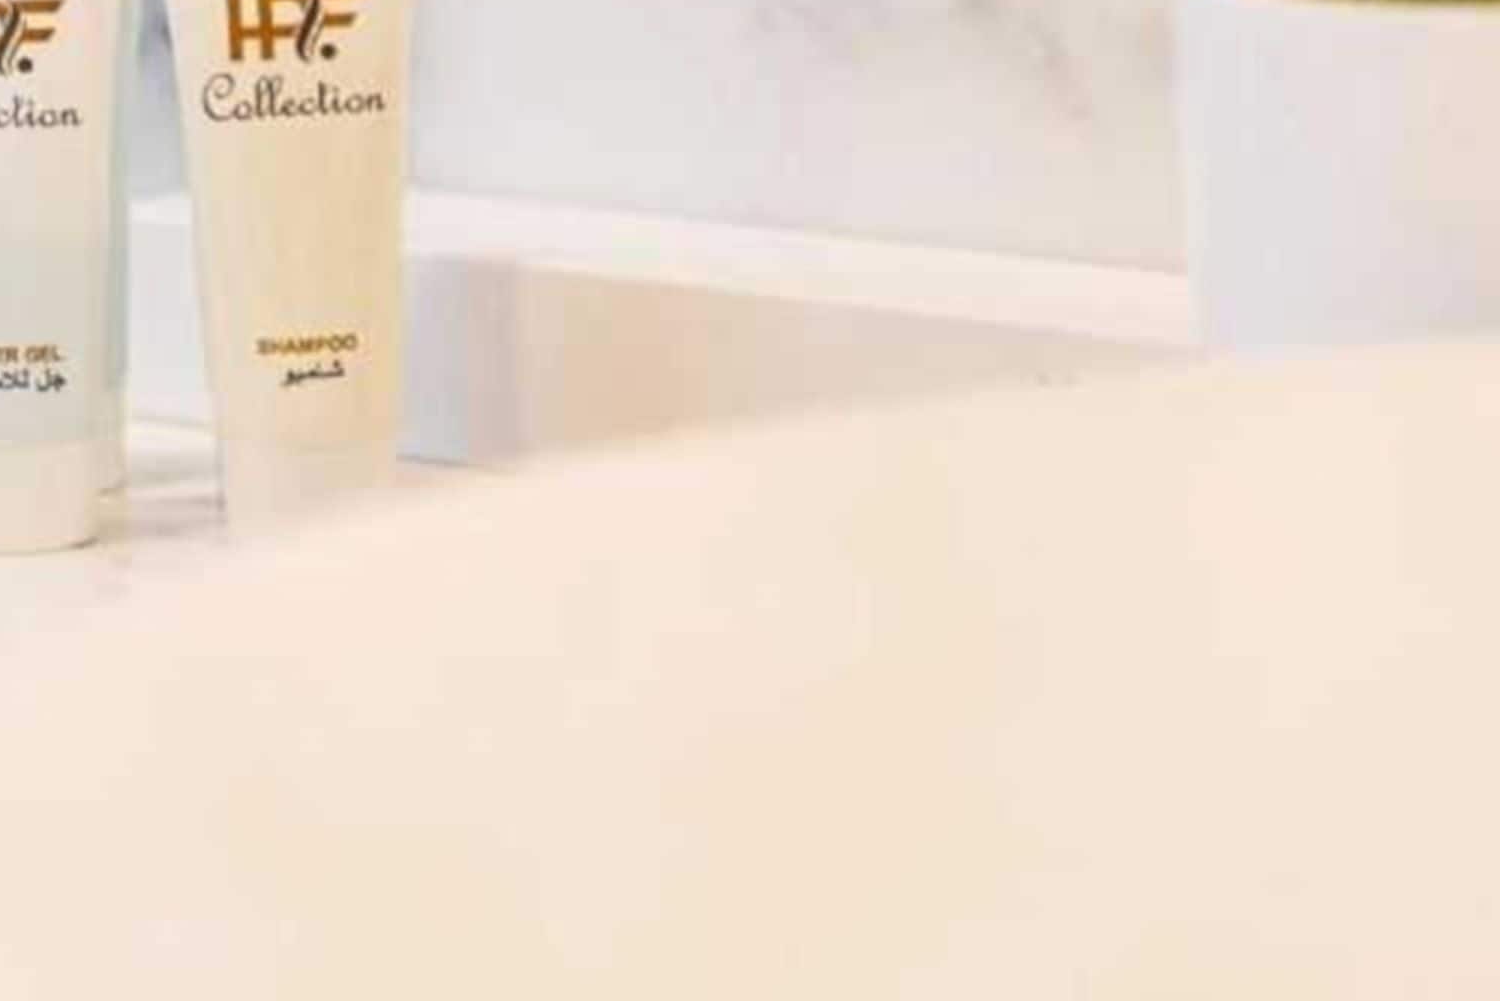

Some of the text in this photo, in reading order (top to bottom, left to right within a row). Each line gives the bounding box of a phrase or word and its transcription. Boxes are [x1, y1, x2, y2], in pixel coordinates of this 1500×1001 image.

[202, 72, 387, 122] Collection
[257, 333, 359, 354] SHAMPOO
[24, 345, 66, 364] GEL
